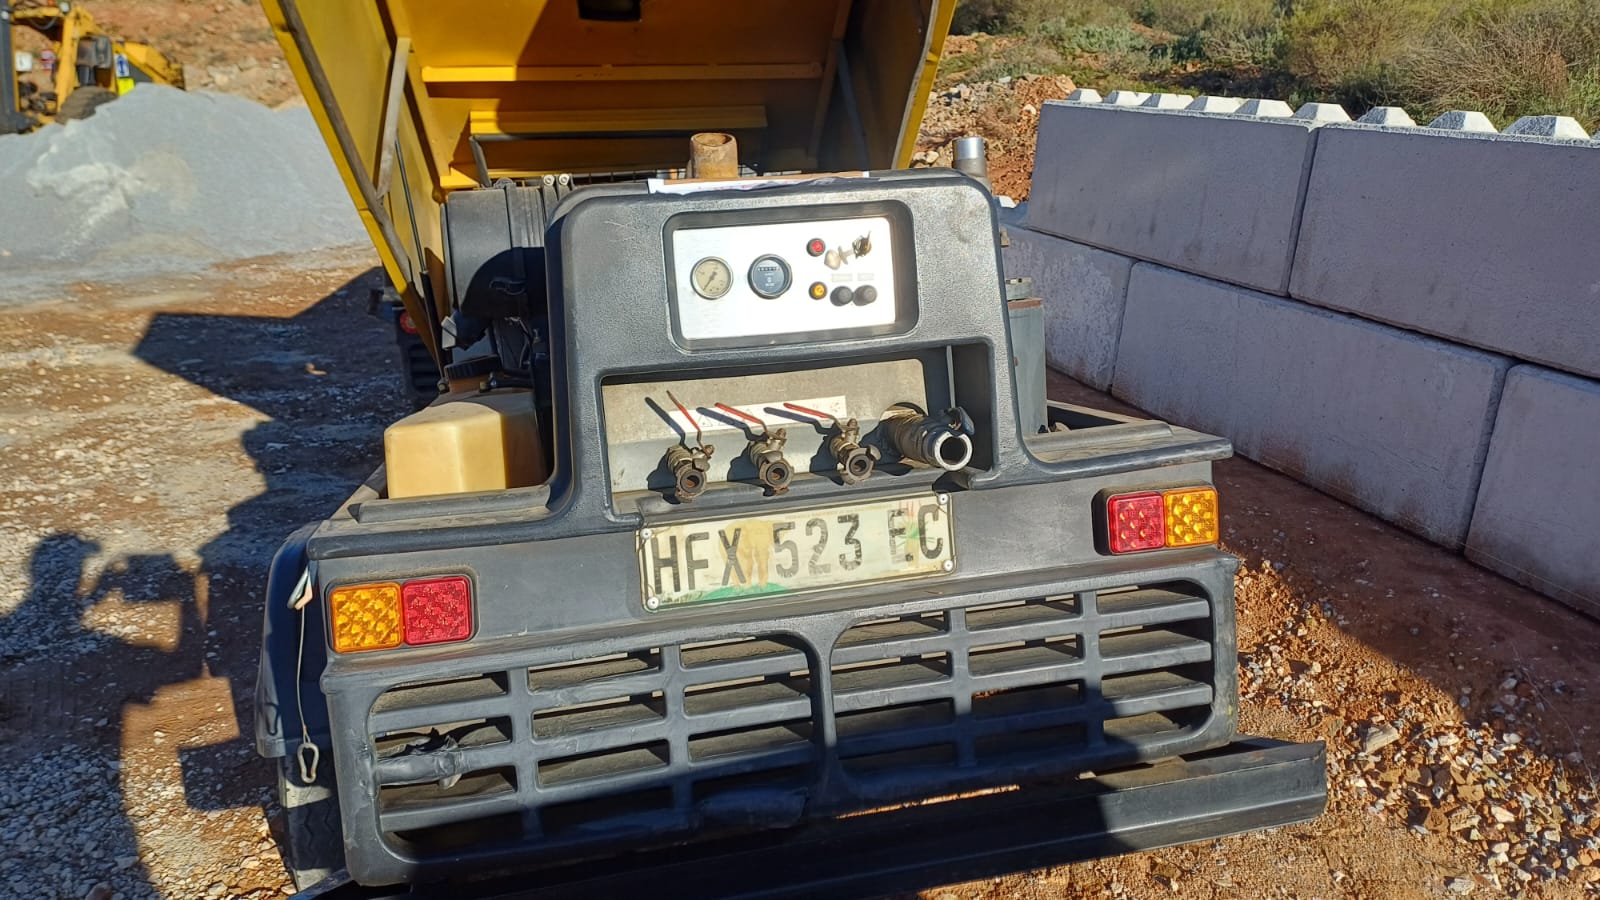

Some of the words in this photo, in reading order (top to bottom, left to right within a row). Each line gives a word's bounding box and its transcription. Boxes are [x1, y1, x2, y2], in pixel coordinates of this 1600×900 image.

[650, 527, 747, 595] HFX
[772, 512, 864, 579] 523
[887, 503, 944, 565] EC
